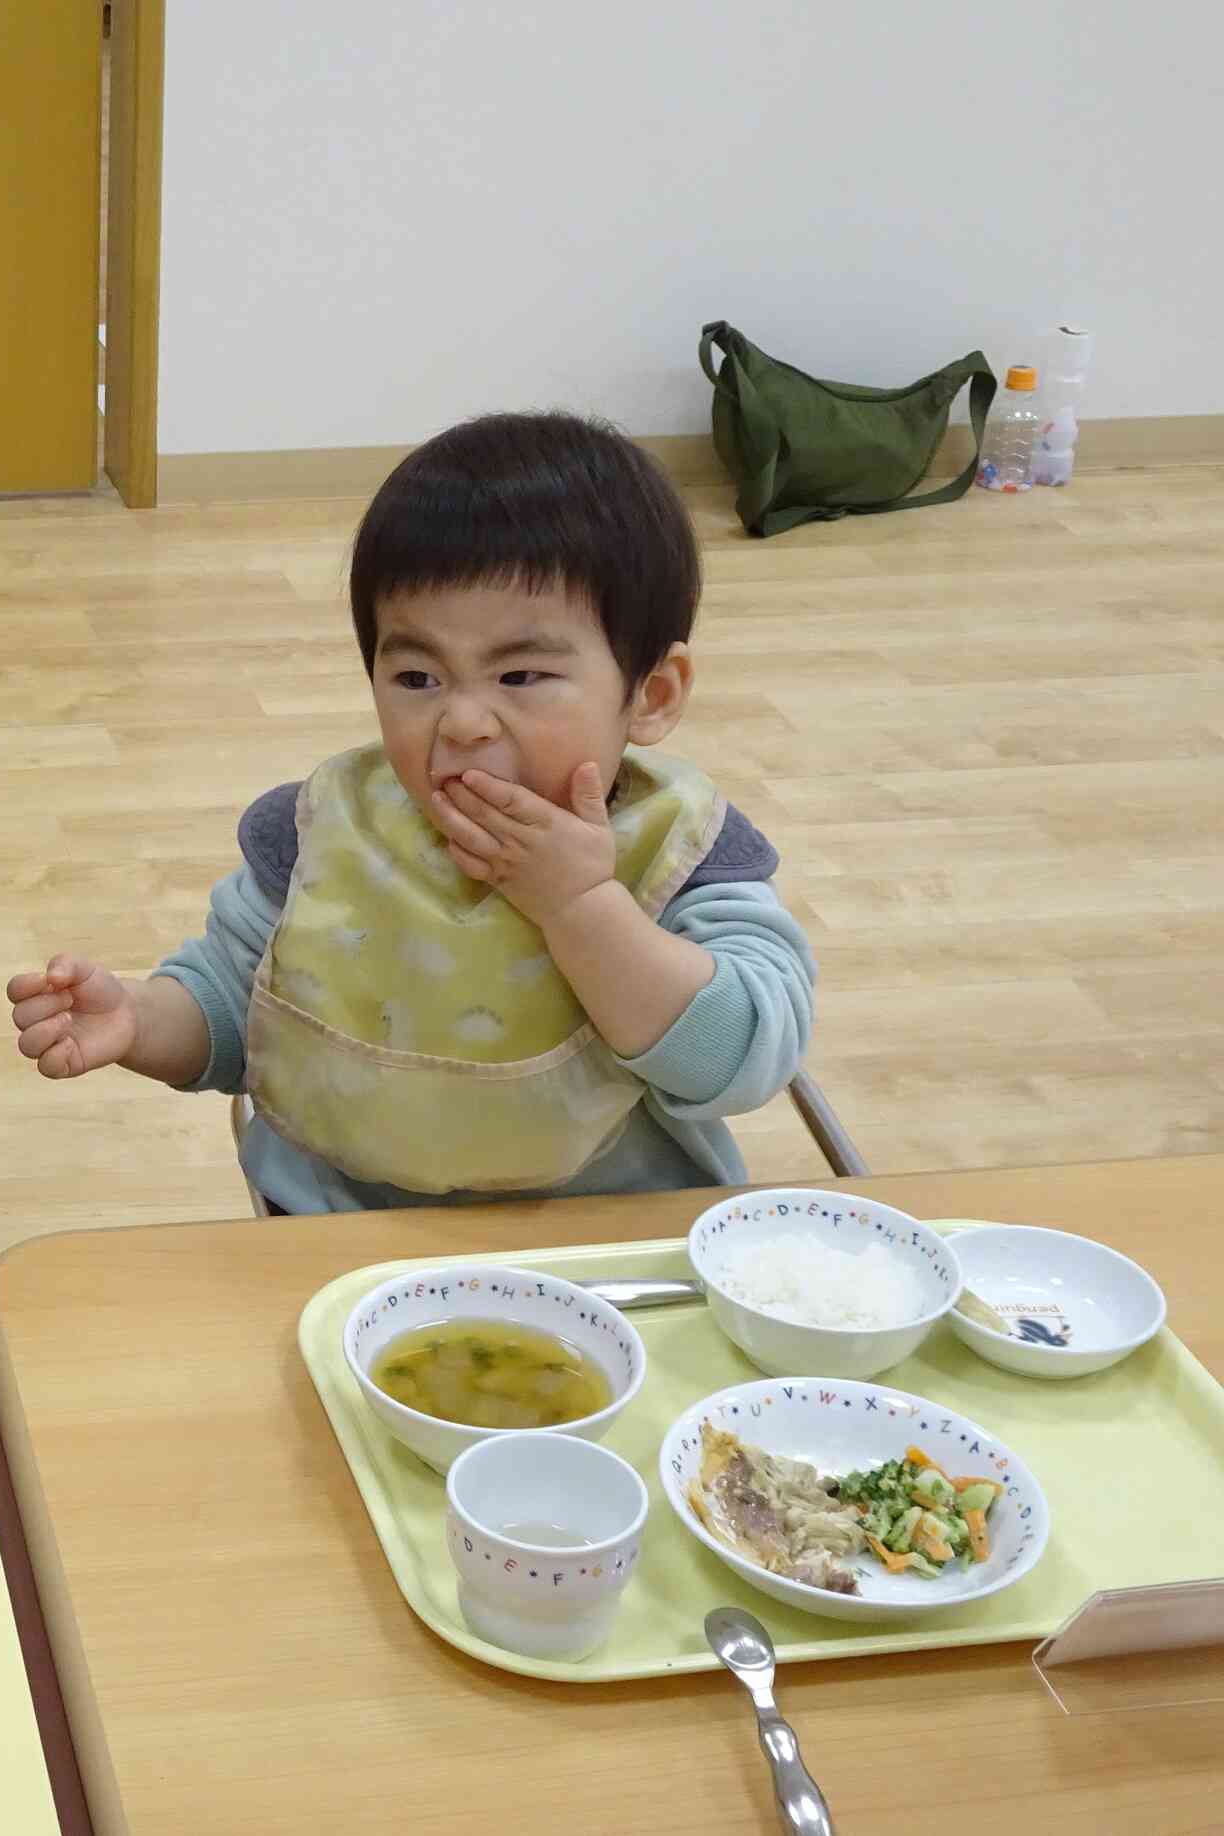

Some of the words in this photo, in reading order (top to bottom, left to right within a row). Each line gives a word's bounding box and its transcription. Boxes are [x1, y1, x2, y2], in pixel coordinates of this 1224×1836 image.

[778, 1204, 789, 1216] D
[807, 1203, 819, 1216] E
[833, 1213, 842, 1227] F
[912, 1232, 919, 1245] I
[388, 1296, 397, 1307] D
[415, 1283, 424, 1298] E
[440, 1286, 449, 1300] F
[502, 1285, 514, 1299] H
[536, 1283, 544, 1296] I
[752, 1404, 761, 1416] U
[784, 1387, 793, 1399] V
[820, 1390, 836, 1404] W
[865, 1397, 878, 1410] X
[941, 1420, 952, 1433] Z
[969, 1441, 980, 1454] A
[552, 1573, 563, 1586] F
